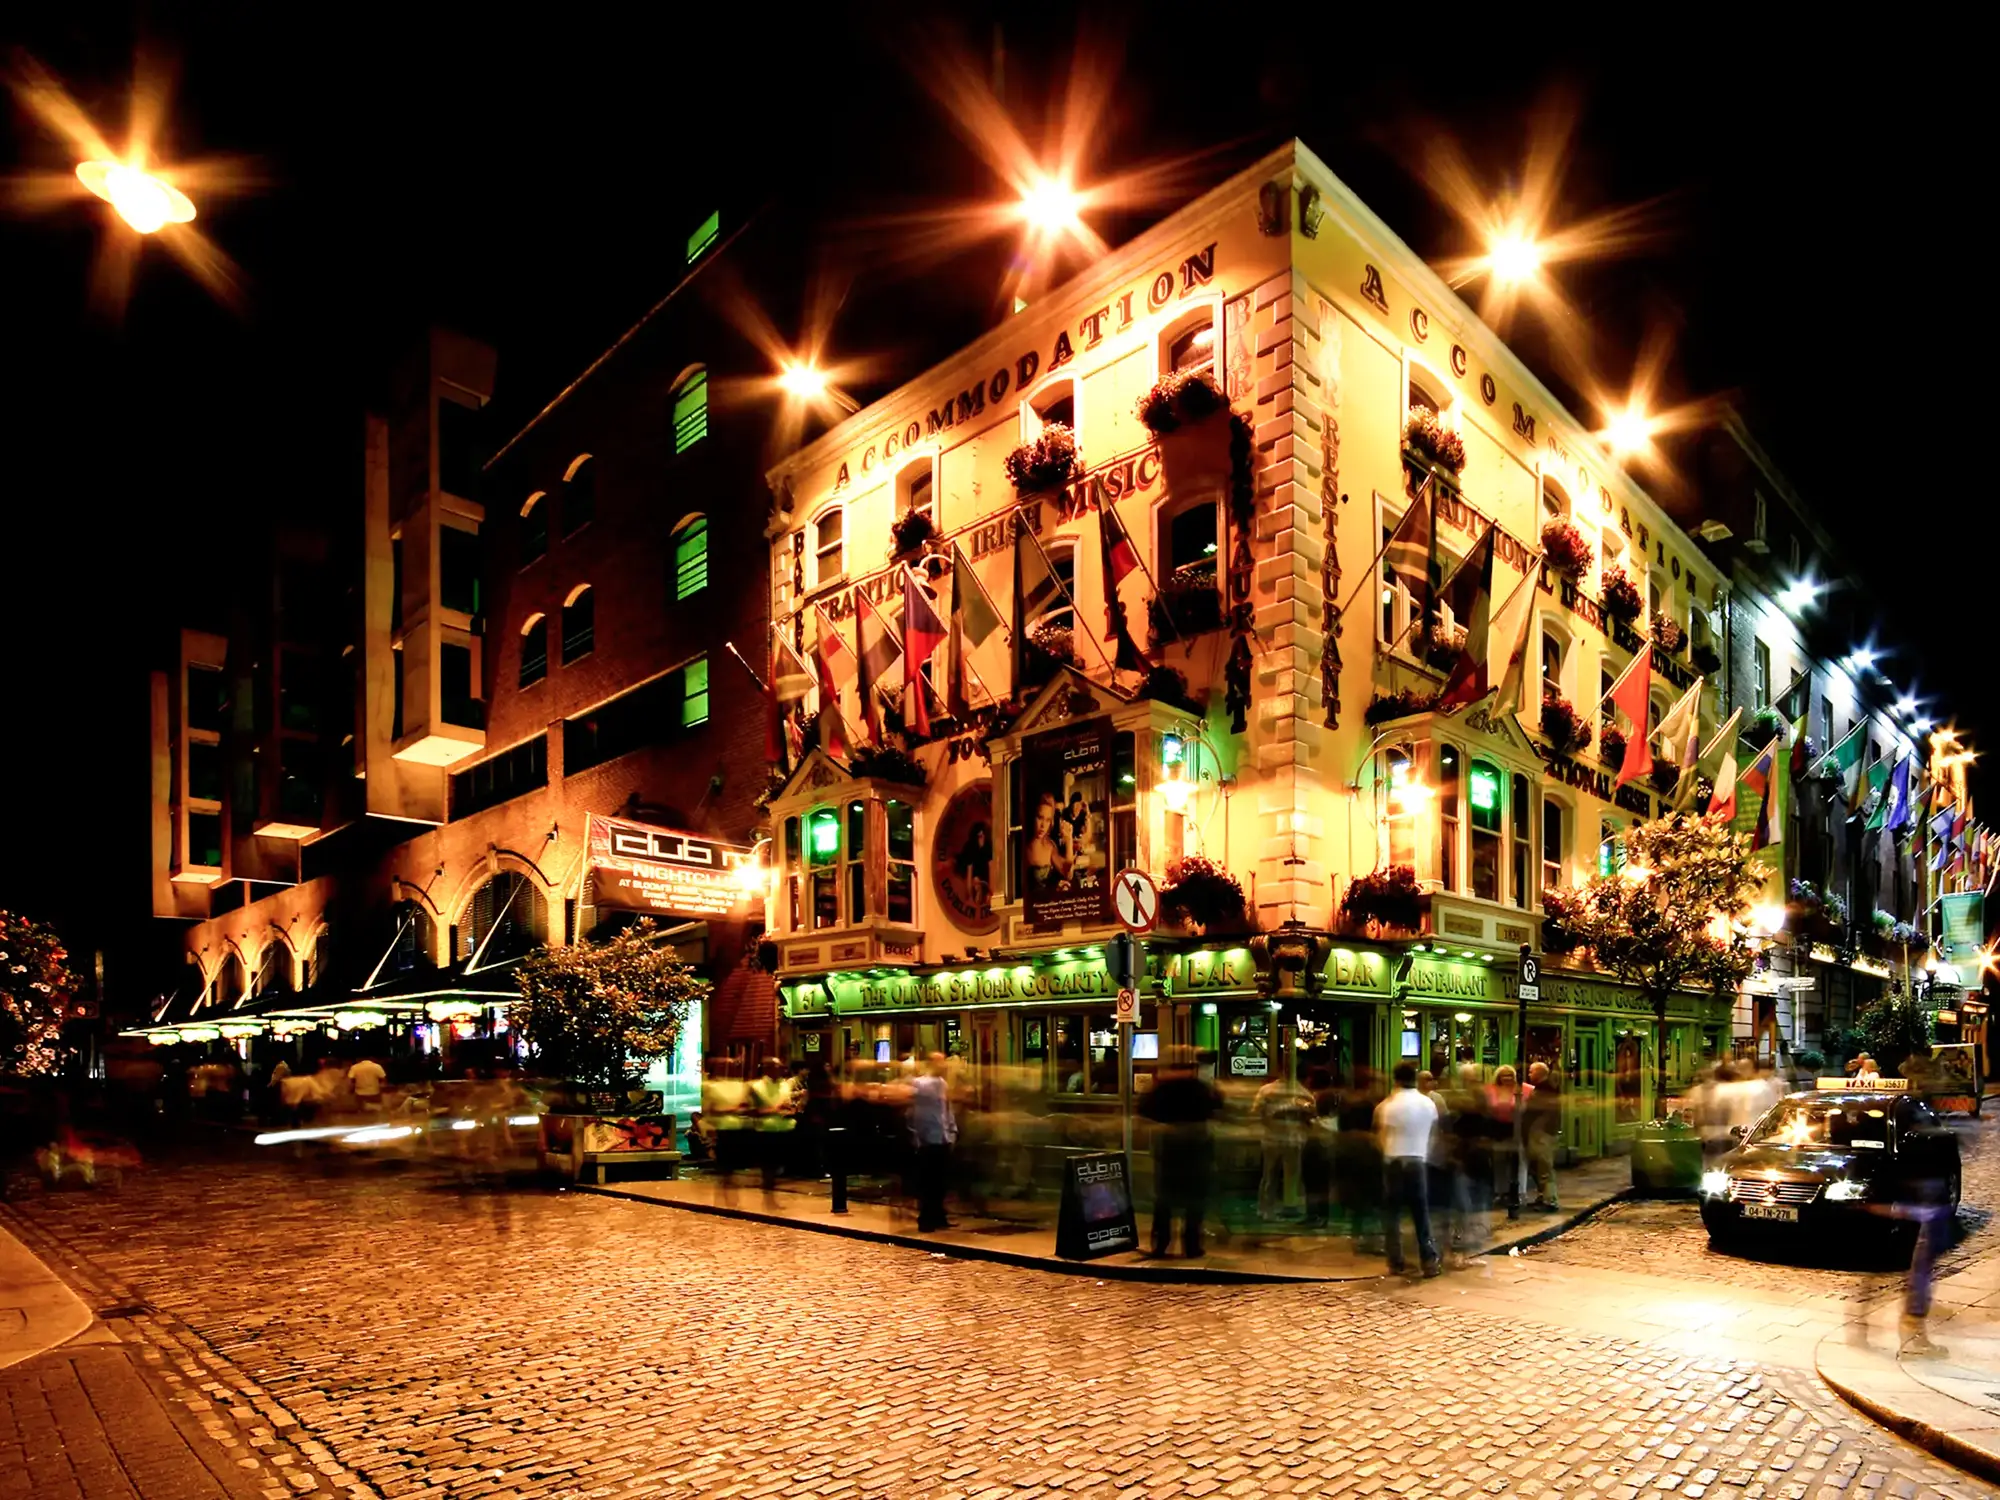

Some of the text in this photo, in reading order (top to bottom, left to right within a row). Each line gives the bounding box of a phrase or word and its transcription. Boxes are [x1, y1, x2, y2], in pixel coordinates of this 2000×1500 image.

[833, 243, 1218, 493] ACCOMMODATION
[1227, 301, 1252, 402] BAR
[1359, 263, 1698, 597] ACCOMMODATION
[970, 501, 1043, 563] IRISH
[1056, 452, 1162, 526] MUSIC
[1319, 412, 1344, 731] RESTAURANT
[615, 832, 713, 865] club
[619, 878, 632, 887] AT
[632, 865, 744, 887] NIGHTCLU
[1187, 957, 1242, 988] BAR
[1335, 955, 1378, 988] BAR
[1408, 966, 1488, 997] RESTAURANT
[859, 984, 888, 1008] THE
[890, 979, 945, 1005] OLIVER
[1020, 969, 1110, 997] GOGARTY
[1846, 1080, 1875, 1090] TAXI
[1077, 1161, 1108, 1176] club
[1087, 1225, 1131, 1241] open
